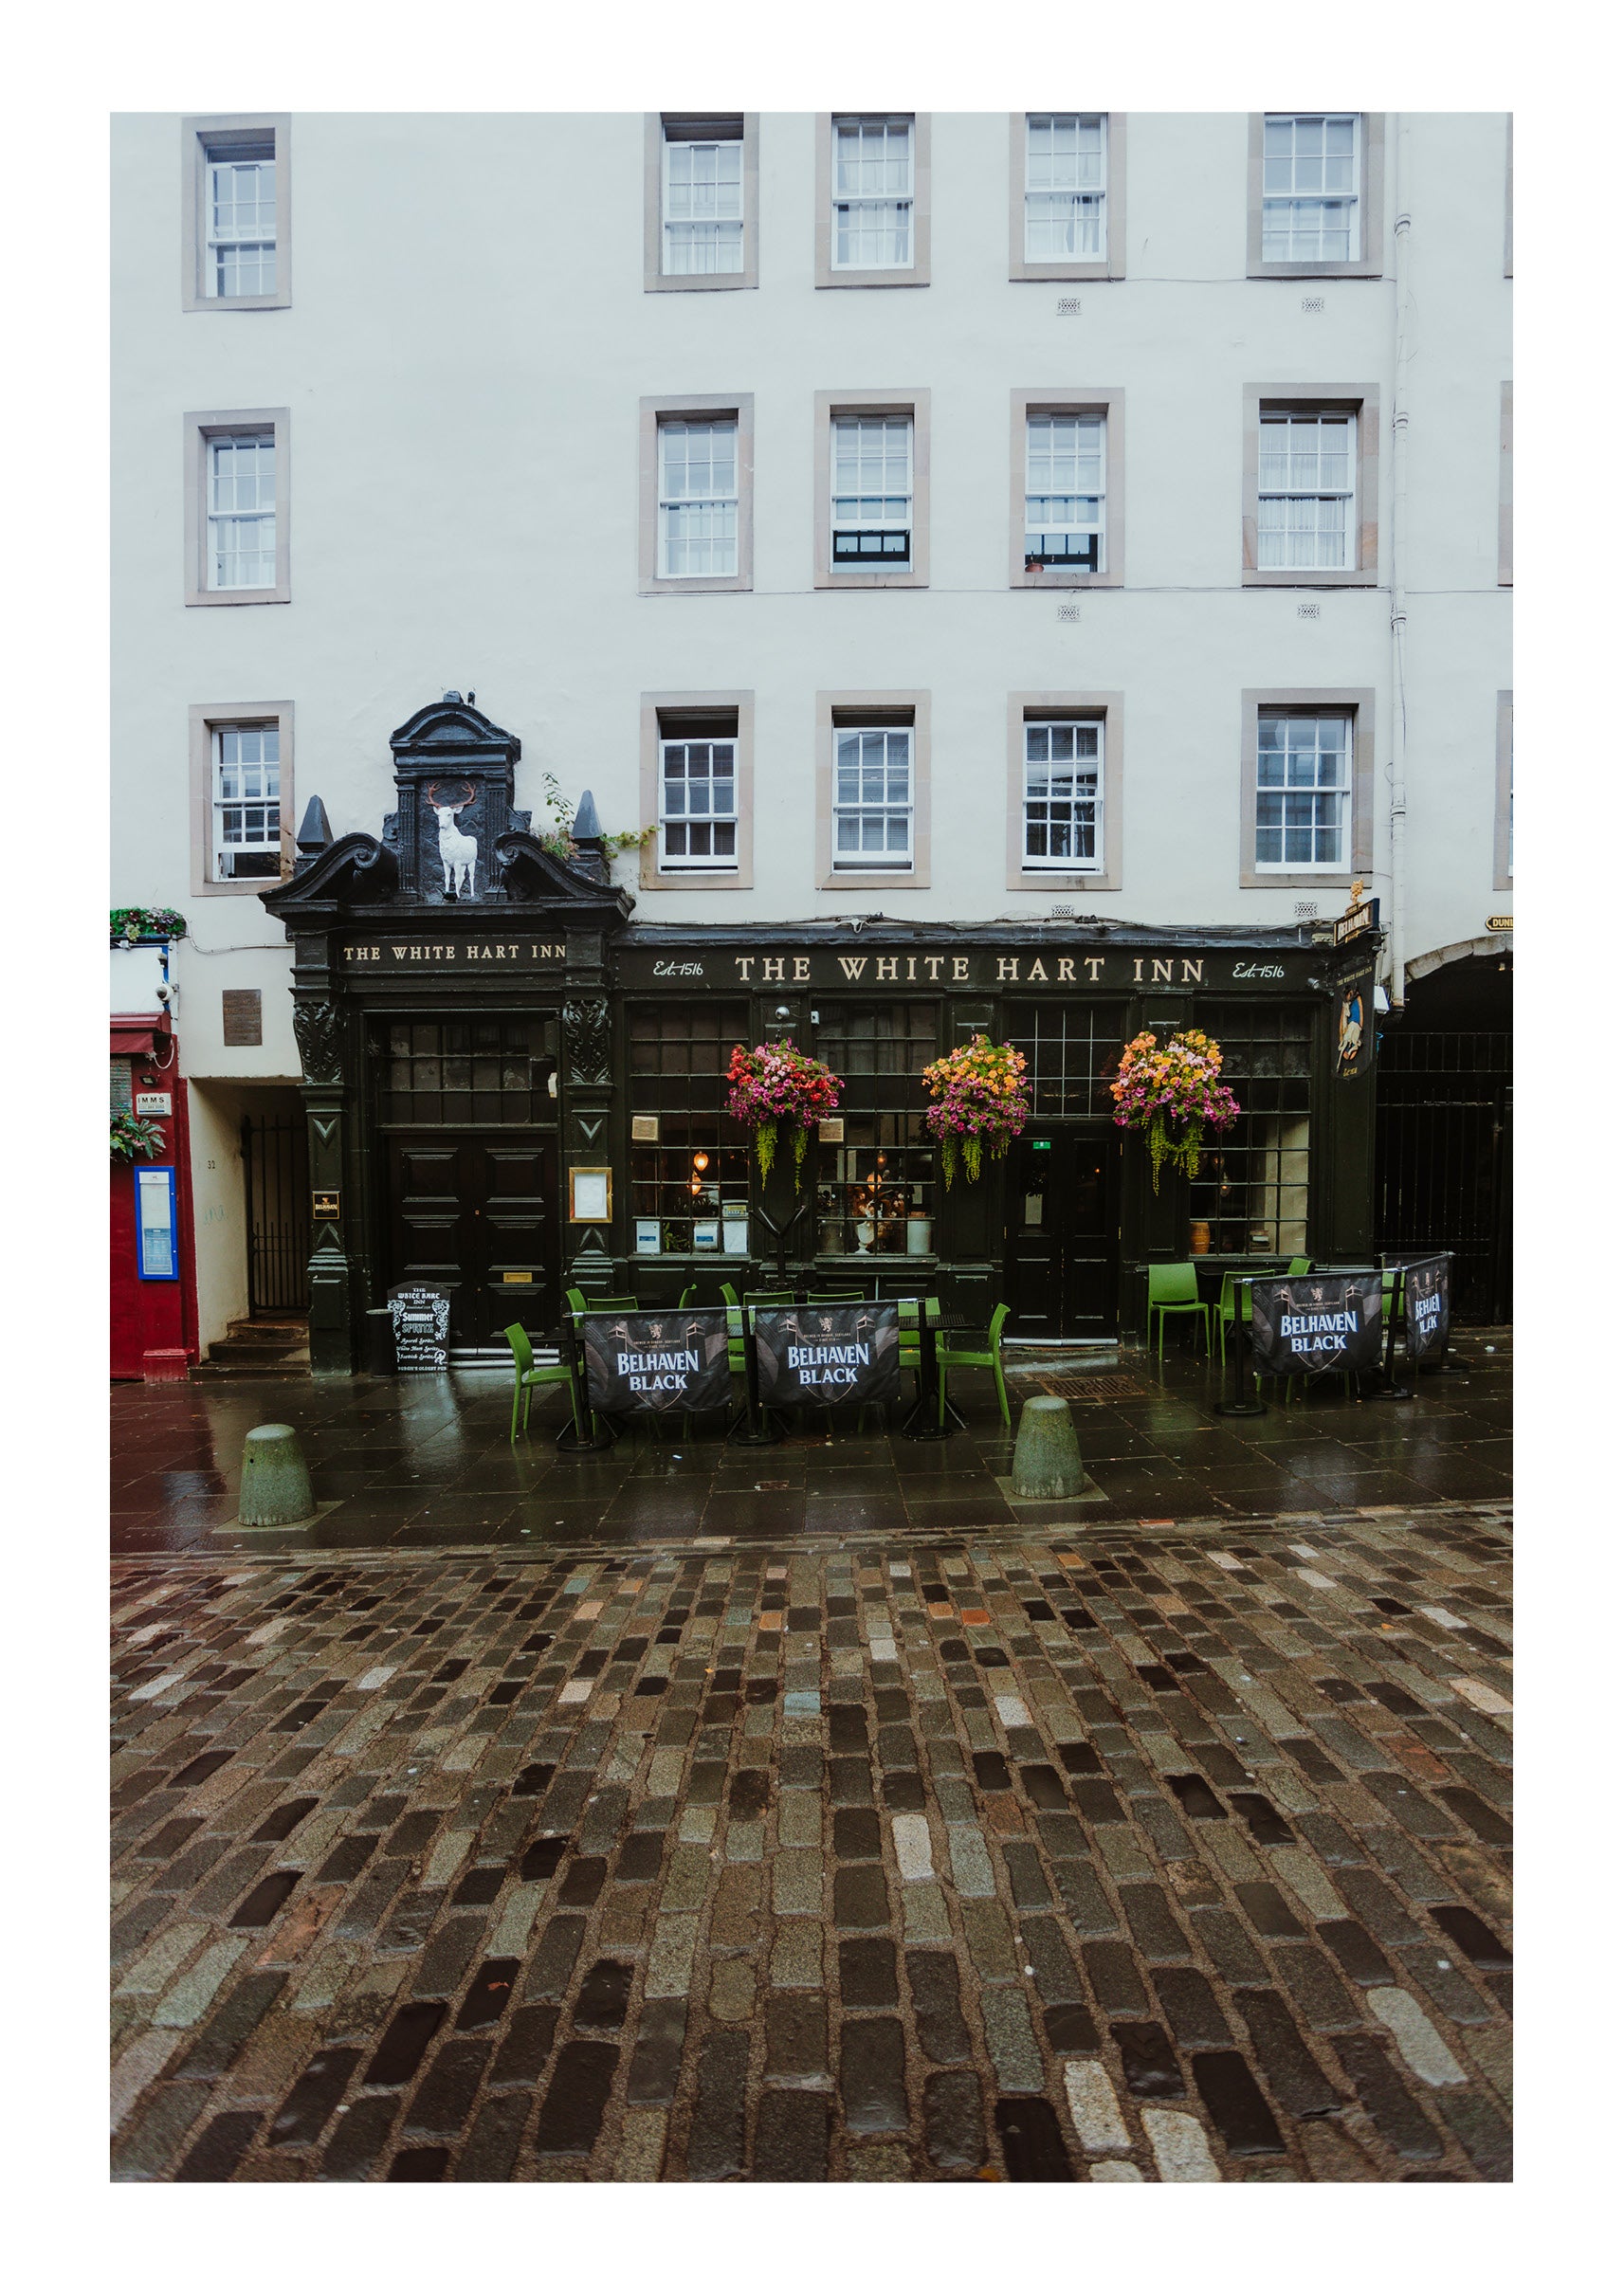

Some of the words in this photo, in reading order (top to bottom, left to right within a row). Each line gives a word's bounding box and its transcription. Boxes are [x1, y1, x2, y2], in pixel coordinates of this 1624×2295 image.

[343, 947, 380, 960] THE
[392, 946, 455, 960] WHITE
[466, 945, 520, 959] HART
[532, 945, 566, 958] INN
[653, 961, 678, 975] Est.
[680, 963, 703, 975] 1516
[735, 956, 811, 980] THE
[837, 956, 969, 981] WHITE
[995, 957, 1104, 981] HART
[1133, 958, 1204, 982] INN
[1232, 962, 1257, 977] Est.
[1259, 964, 1285, 977] 1516
[208, 1160, 216, 1169] 32
[402, 1312, 434, 1321] Summer
[1281, 1311, 1358, 1337] BELHAVEN
[402, 1322, 434, 1334] SPRITZ
[1291, 1335, 1347, 1353] BLACK
[617, 1350, 700, 1375] BELHAVEN
[788, 1343, 870, 1369] BELHAVEN
[630, 1375, 688, 1391] BLACK
[799, 1367, 858, 1385] BLACK
